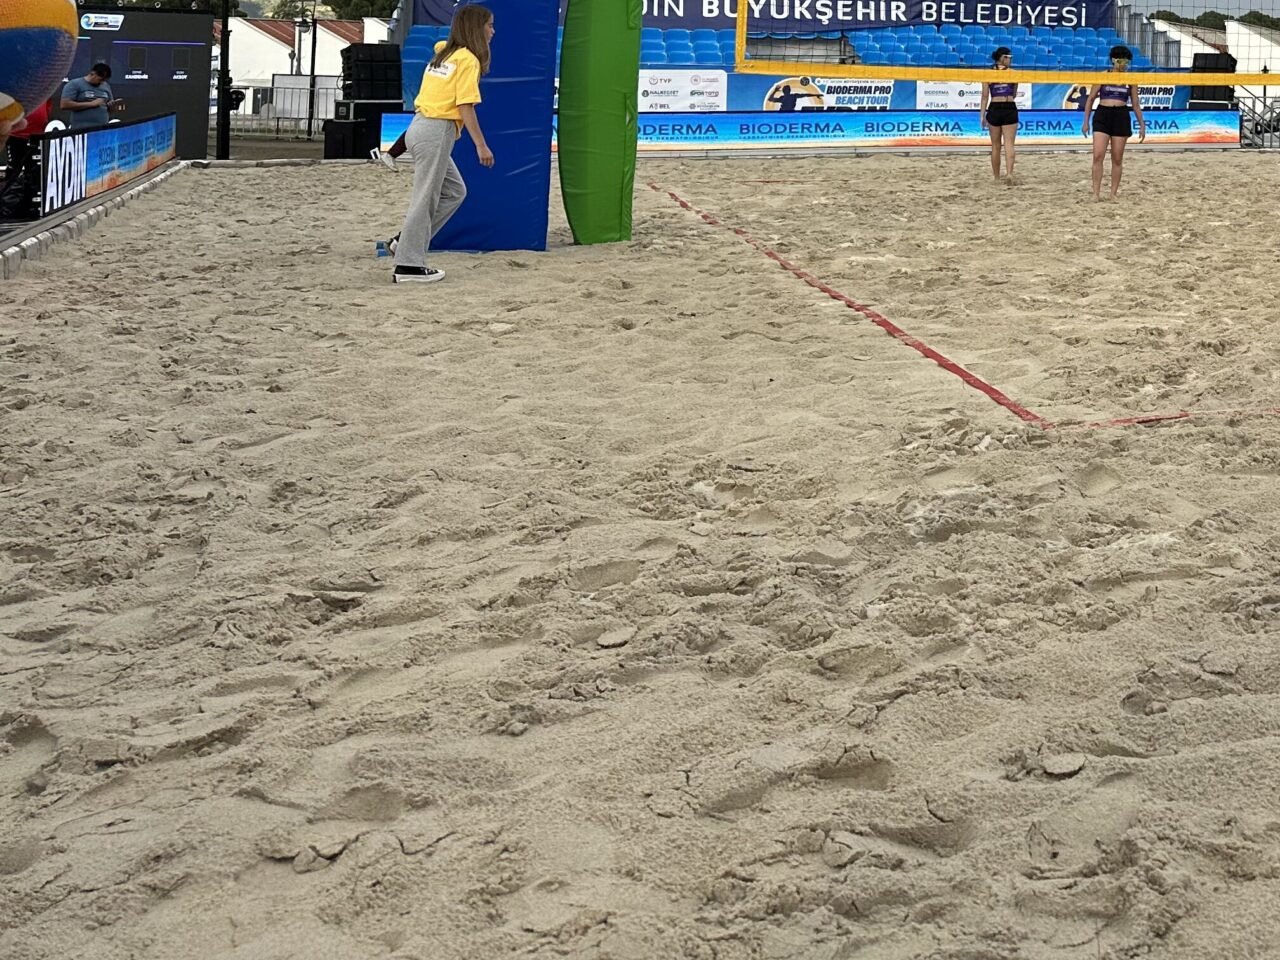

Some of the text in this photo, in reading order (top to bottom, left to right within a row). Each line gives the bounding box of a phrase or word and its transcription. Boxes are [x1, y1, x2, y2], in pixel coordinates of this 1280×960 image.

[922, 0, 1087, 27] BELEDİYESİ
[826, 86, 891, 95] BIODERMA PRO
[1158, 87, 1174, 95] PRO
[835, 96, 889, 105] BEACH TOUR
[1151, 97, 1172, 105] TOUR
[740, 122, 845, 135] BIODERMA
[864, 121, 963, 133] BIODERMA
[44, 133, 88, 213] AYDIN
